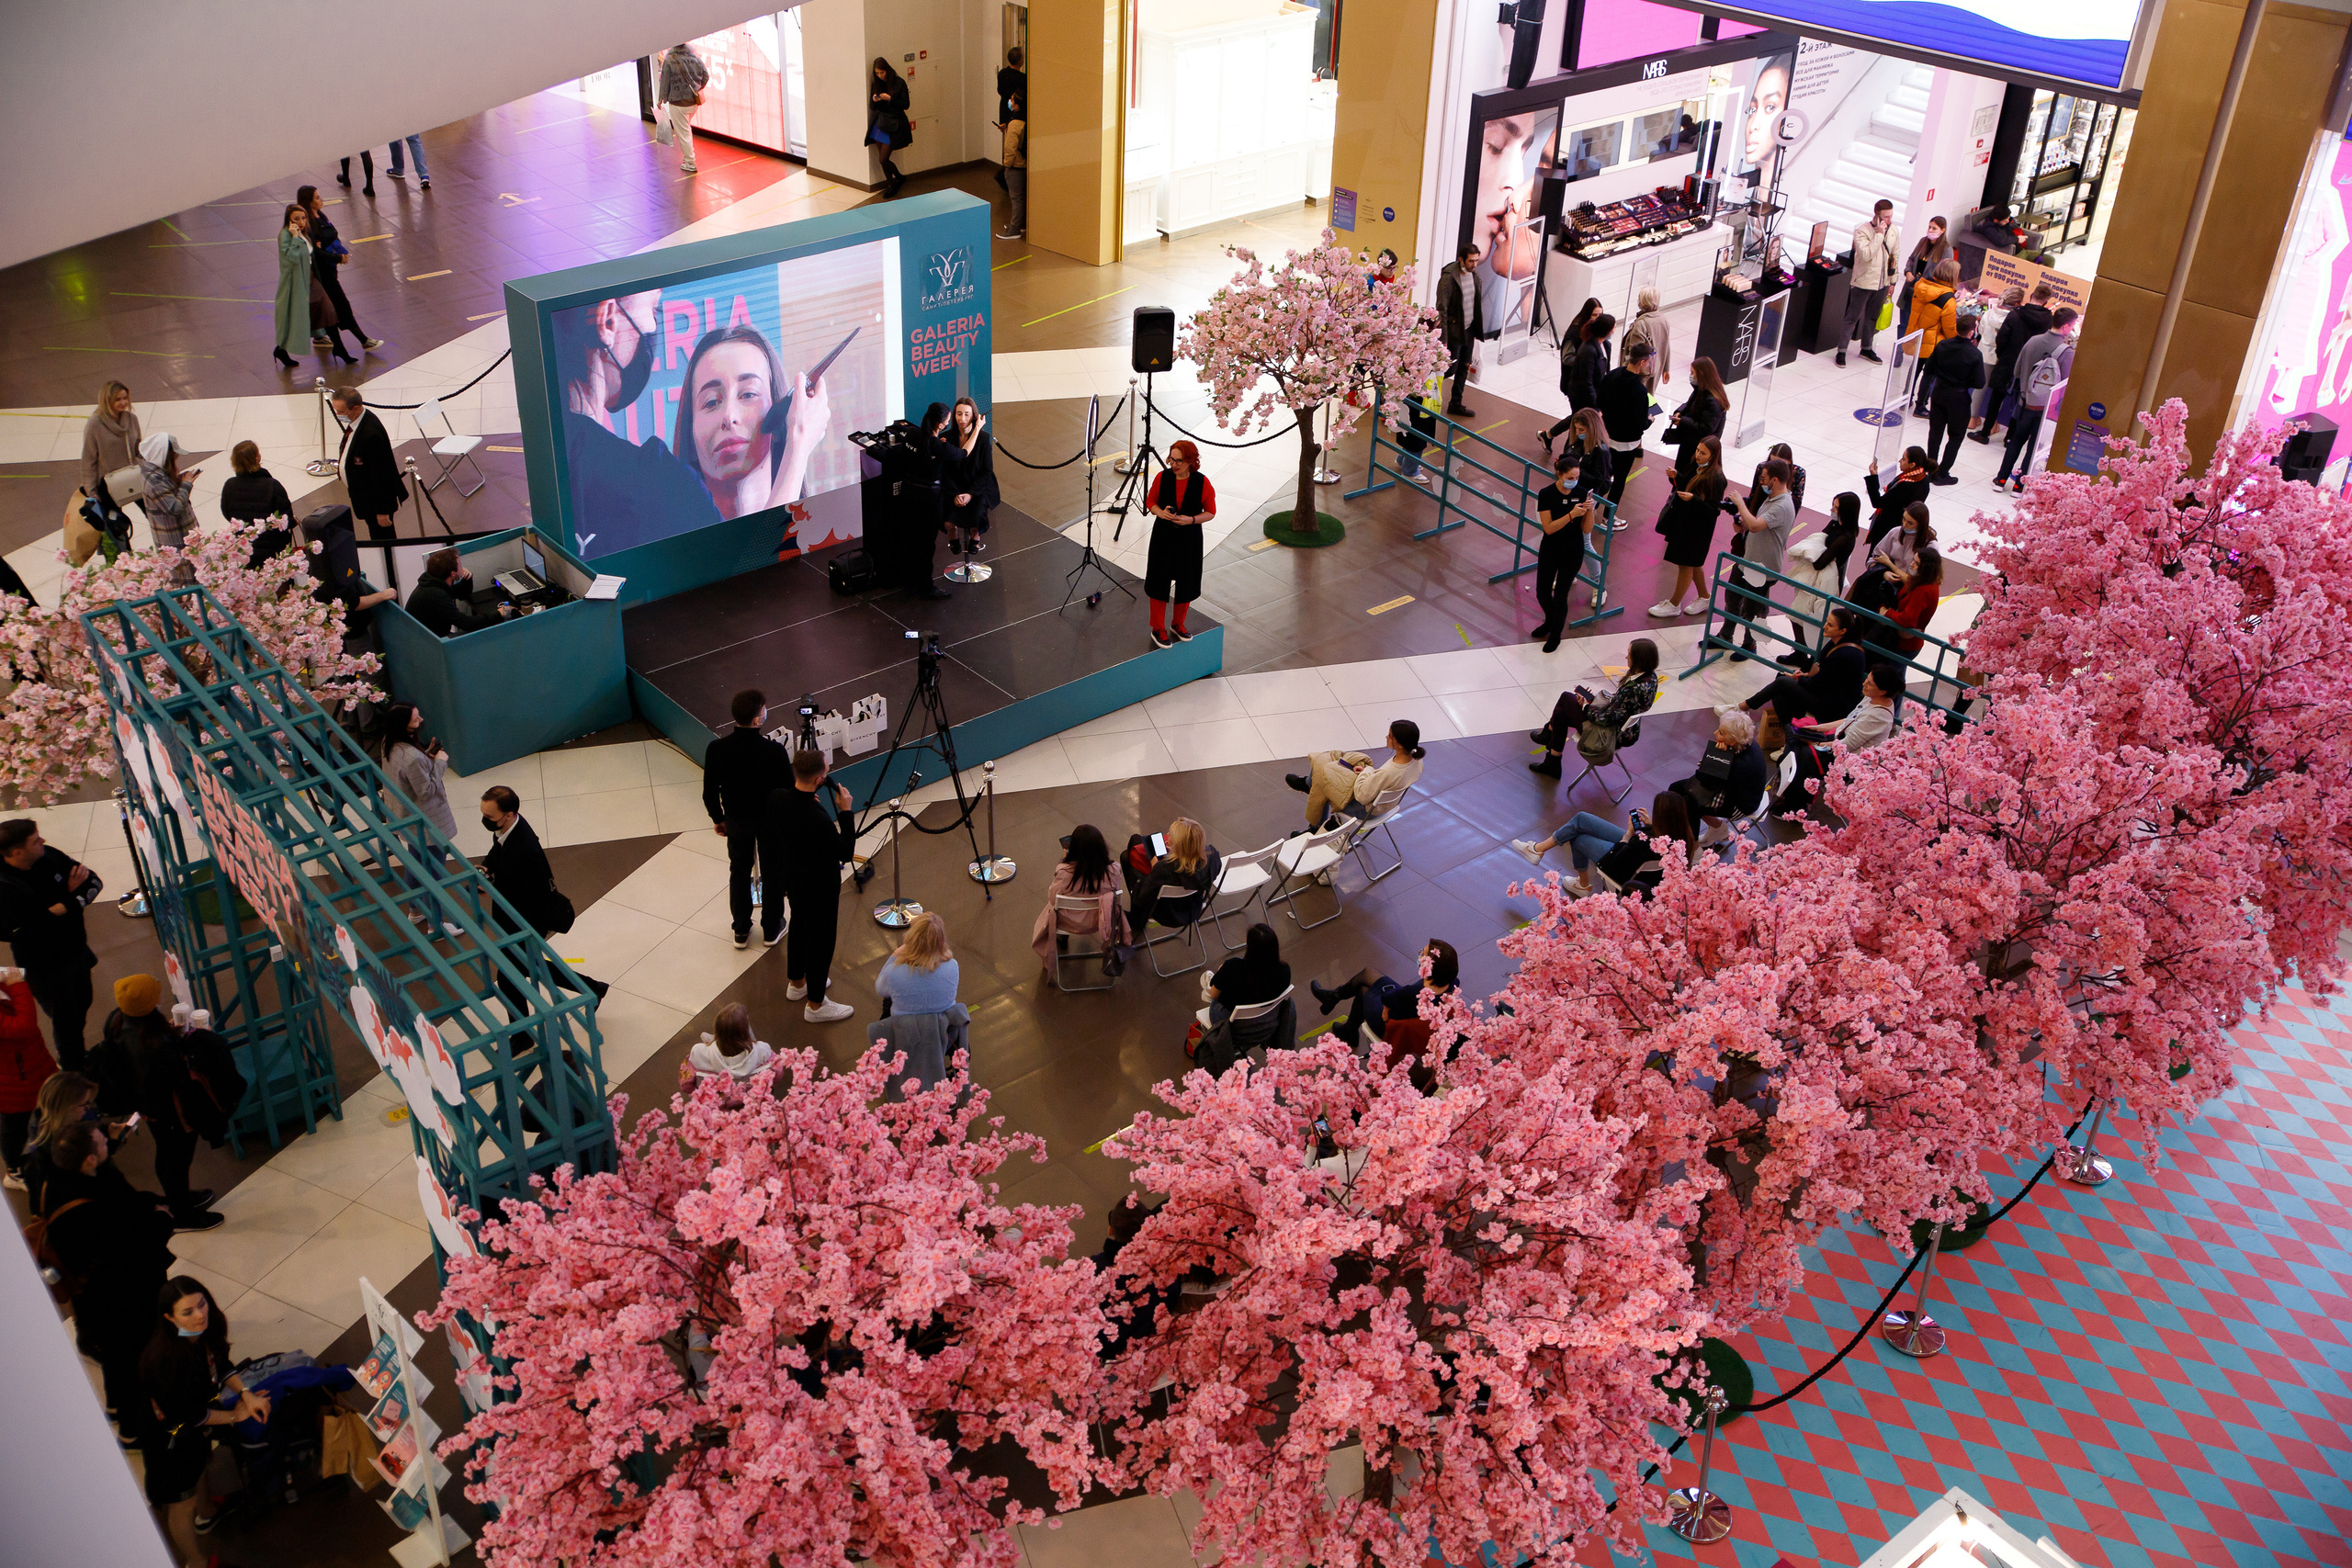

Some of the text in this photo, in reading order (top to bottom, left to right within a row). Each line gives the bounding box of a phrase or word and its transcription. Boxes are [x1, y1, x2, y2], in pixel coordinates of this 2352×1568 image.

[1834, 51, 1855, 59] ВОЛОСАМИ
[592, 71, 611, 83] DIOR
[1643, 59, 1668, 80] NARS
[1815, 69, 1839, 78] ТЕРРИТОРИЯ
[1989, 255, 2016, 268] Подарок
[1987, 264, 2026, 280] при покупке
[1994, 272, 2006, 281] 990
[2006, 276, 2030, 288] рублей
[2041, 272, 2068, 286] Подарок
[922, 285, 974, 305] ГАЛЕРЕЯ
[2052, 284, 2078, 297] покупке
[922, 294, 974, 311] САНКТ-ПЕТЕРБУРГ
[2060, 294, 2083, 306] рублей
[910, 312, 985, 344] GALERIA
[1732, 305, 1757, 367] NARS
[911, 331, 979, 362] BEAUTY
[911, 351, 962, 378] WEEK
[575, 533, 595, 556] Y
[850, 731, 876, 742] GIVENCHY
[193, 755, 300, 902] GALERIA
[200, 792, 292, 926] BEAUTY
[209, 831, 285, 945] WEEK
